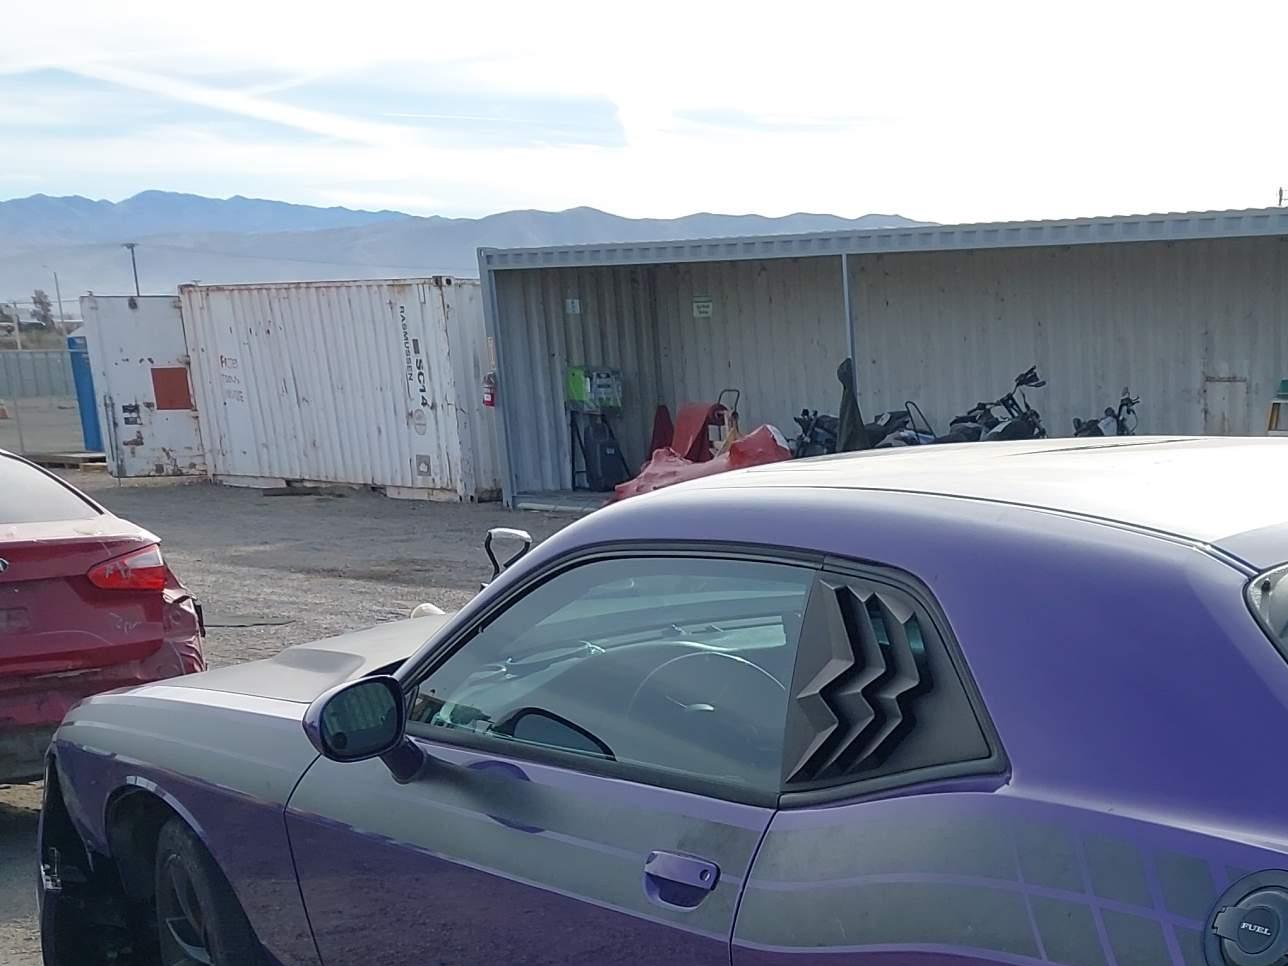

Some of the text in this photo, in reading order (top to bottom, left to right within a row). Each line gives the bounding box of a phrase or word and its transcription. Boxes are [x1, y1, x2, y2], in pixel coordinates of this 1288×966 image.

[400, 305, 414, 382] RASMUSSEN
[415, 357, 432, 408] SC14
[1241, 922, 1272, 936] FUEL
